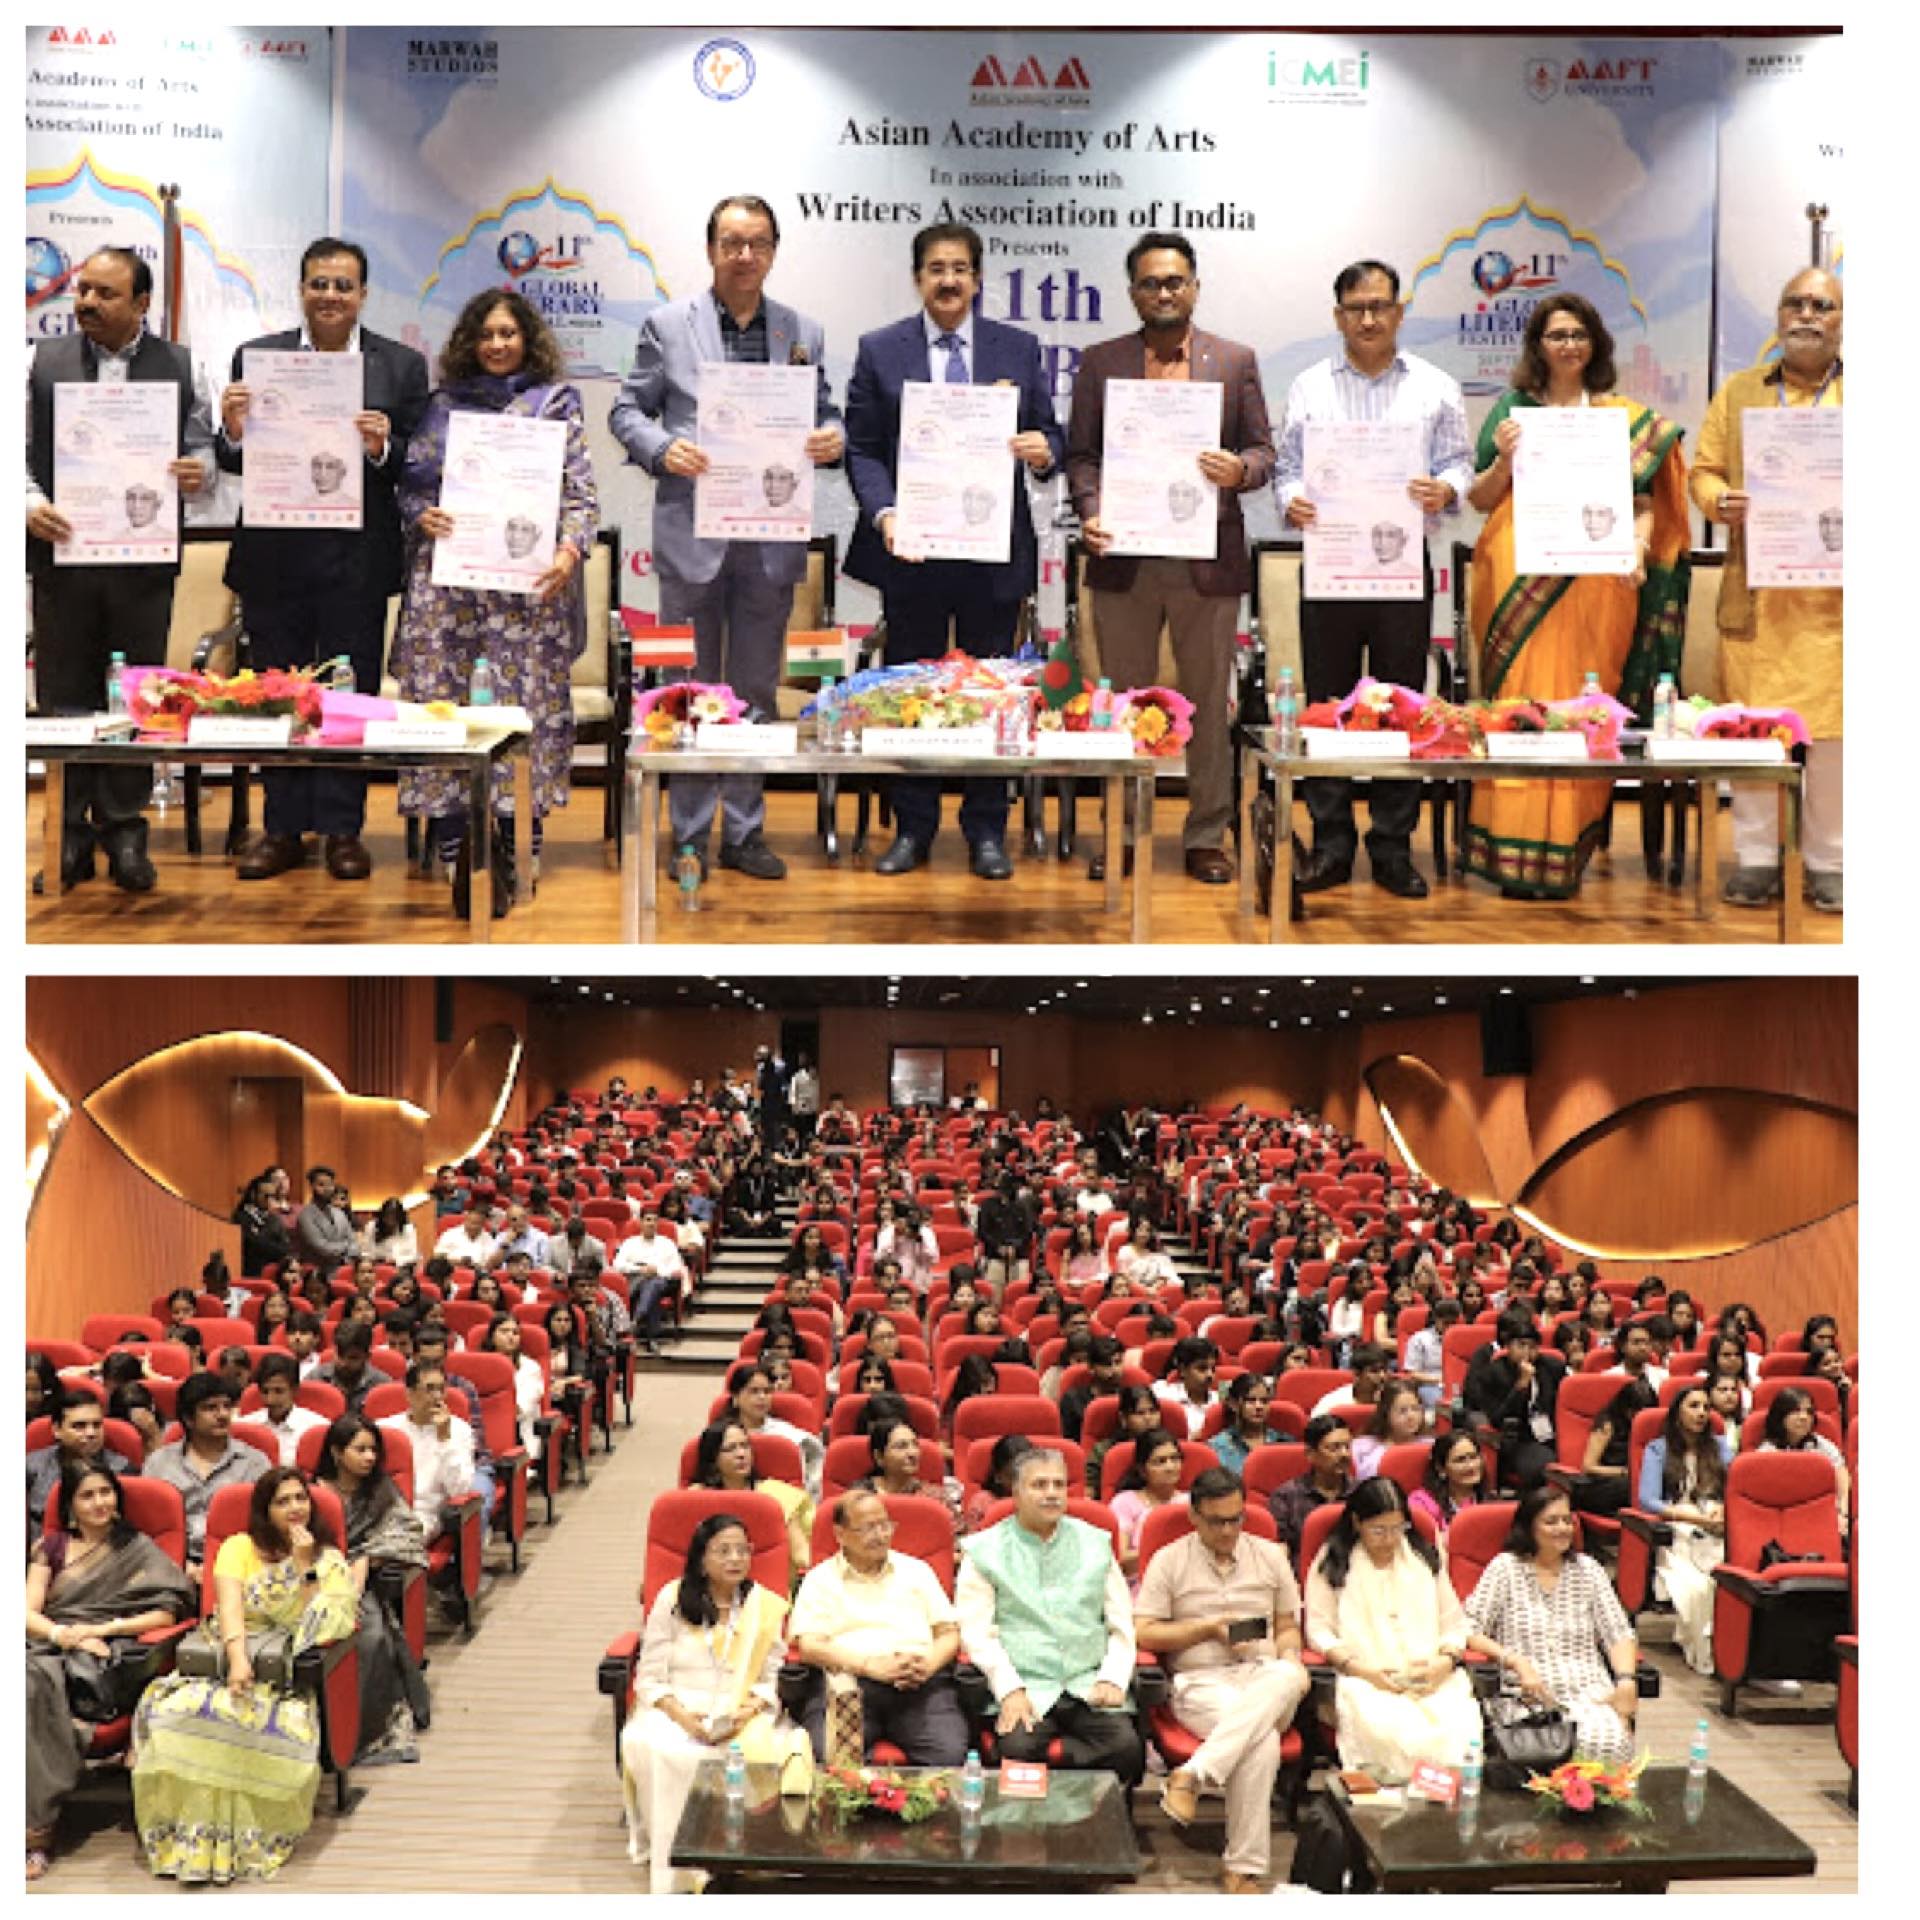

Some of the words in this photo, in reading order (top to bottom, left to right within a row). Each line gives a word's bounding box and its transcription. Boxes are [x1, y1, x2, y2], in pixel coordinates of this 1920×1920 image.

[407, 41, 498, 57] MARWAH
[407, 59, 498, 73] STUDIOS
[1567, 57, 1657, 80] AAFT
[142, 122, 164, 136] of
[173, 123, 223, 139] India
[838, 117, 930, 145] Asian
[941, 118, 1093, 156] Academy
[1104, 122, 1138, 150] of
[1145, 124, 1217, 152] Arts
[930, 166, 952, 185] In
[959, 168, 1069, 187] association
[1078, 169, 1124, 189] with
[797, 193, 921, 221] Writers
[932, 197, 1118, 227] Association
[1128, 202, 1163, 229] of
[1171, 201, 1256, 231] India
